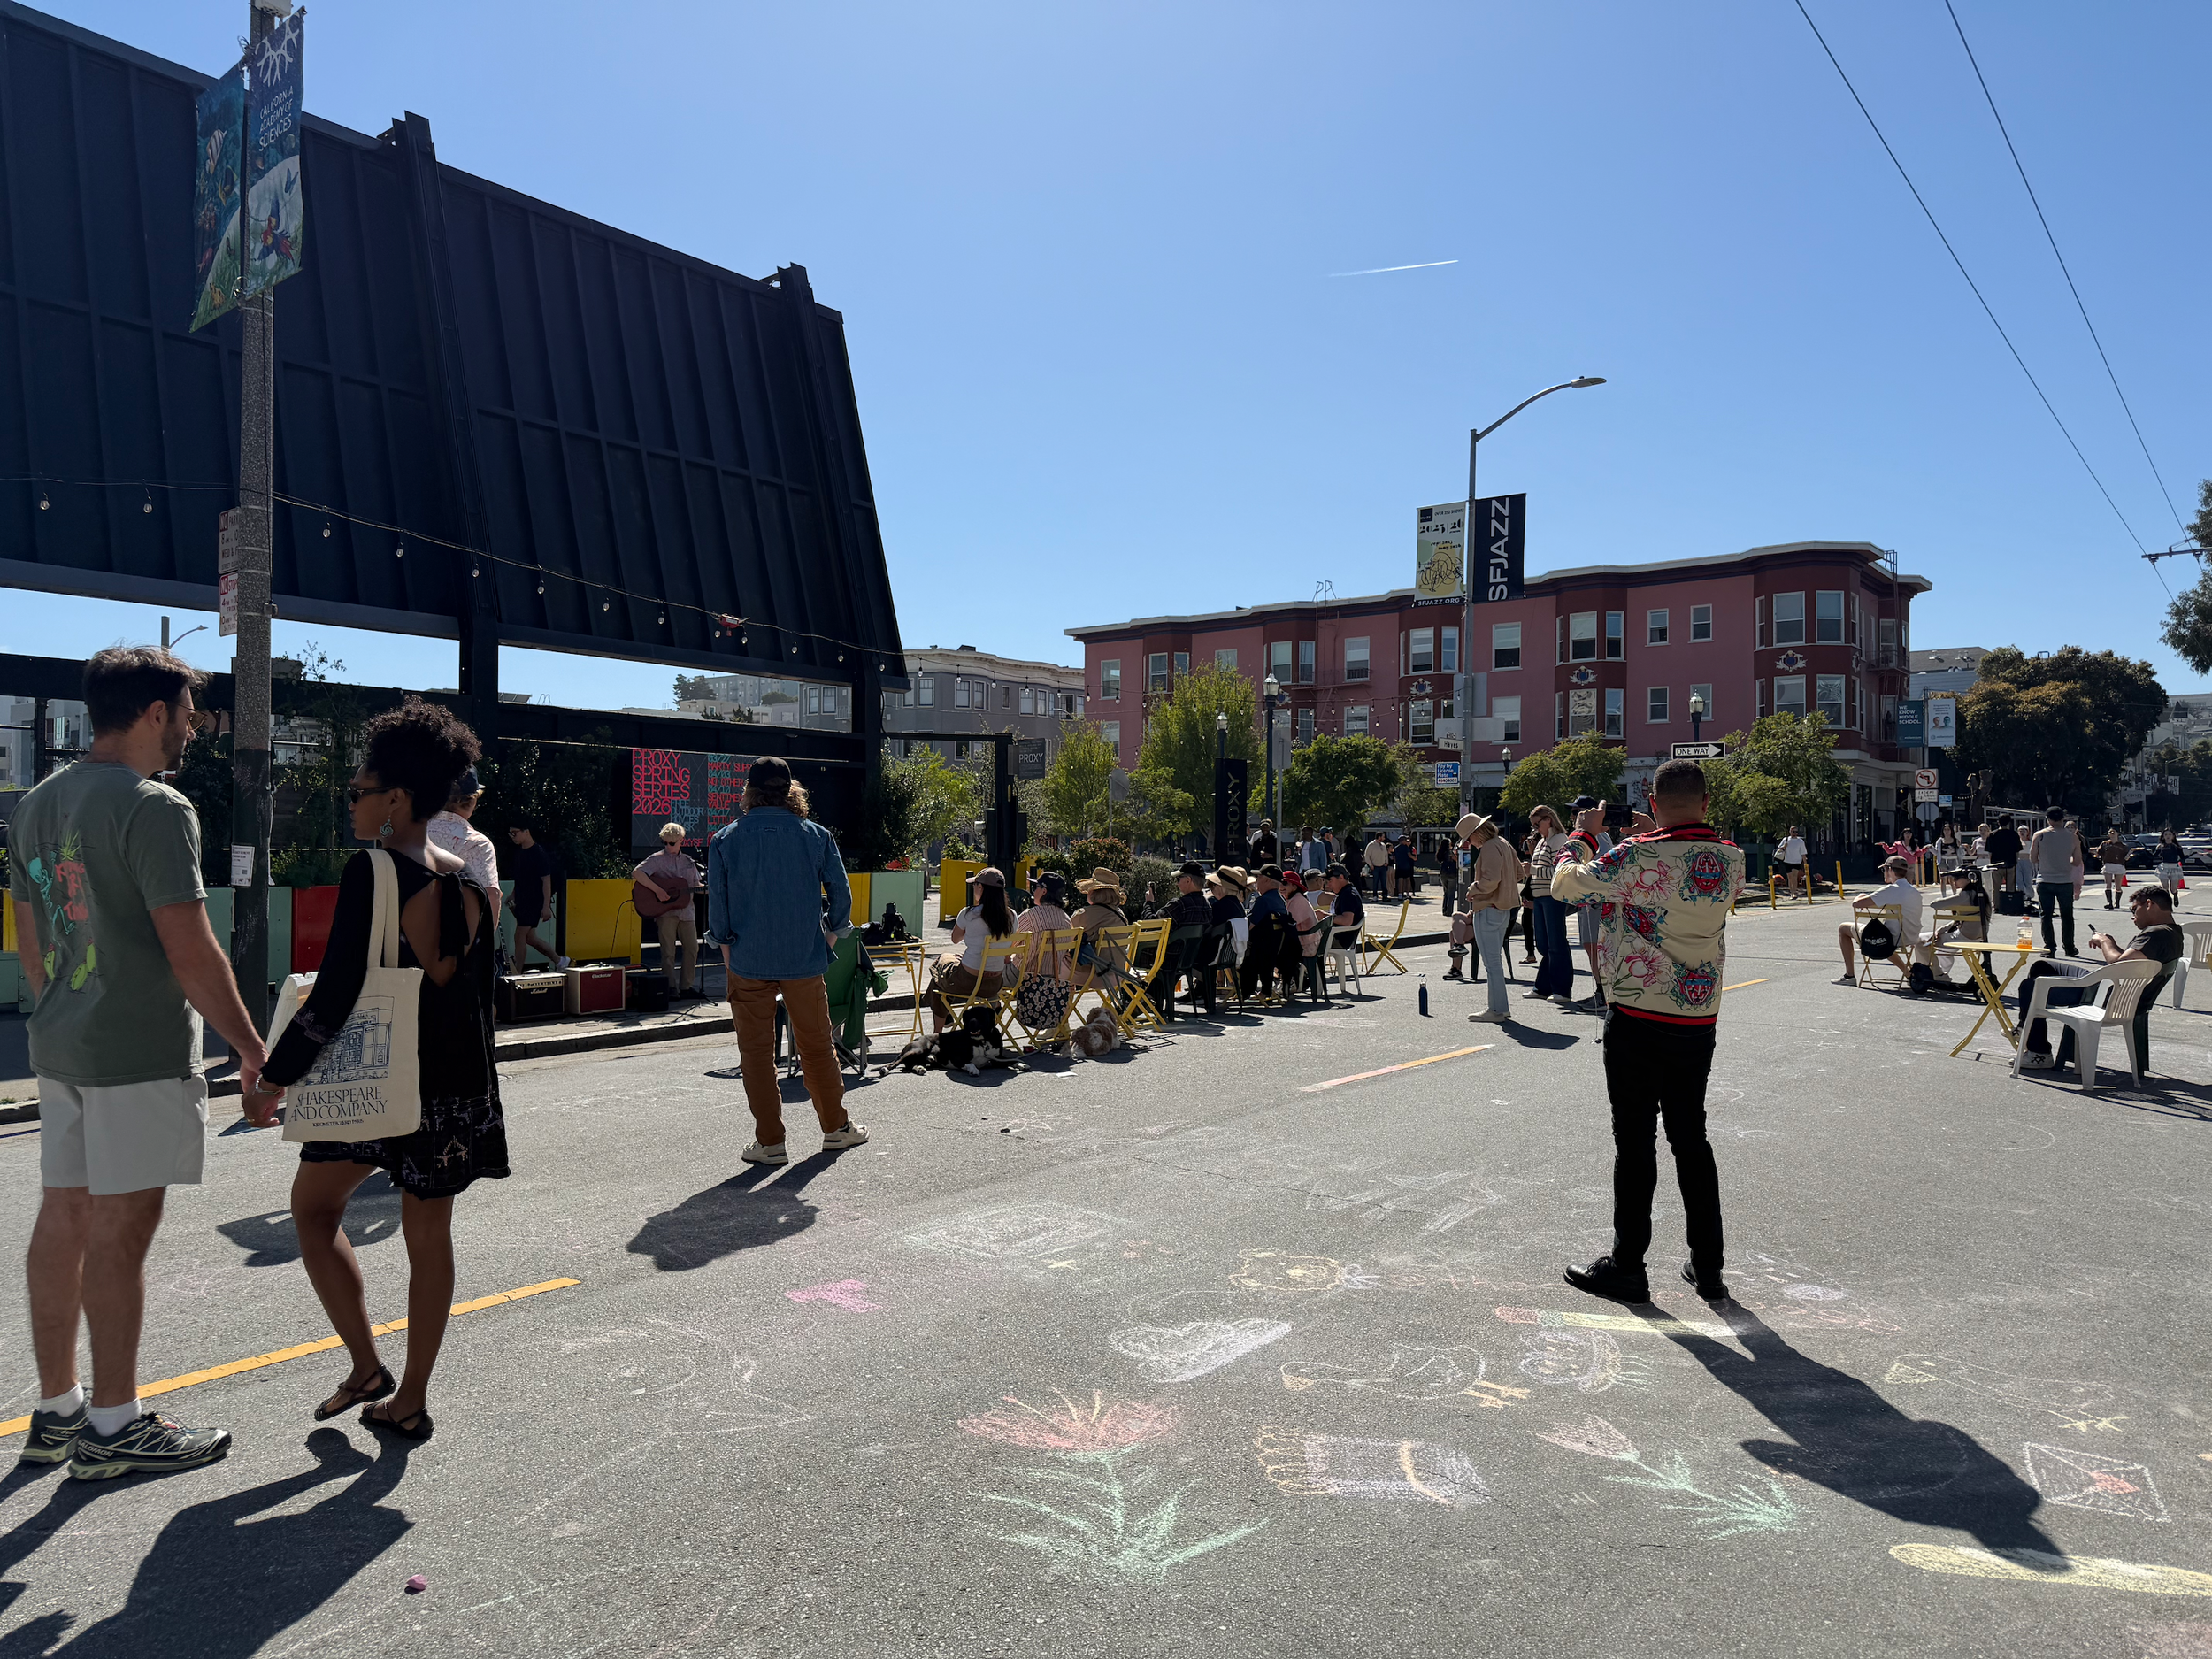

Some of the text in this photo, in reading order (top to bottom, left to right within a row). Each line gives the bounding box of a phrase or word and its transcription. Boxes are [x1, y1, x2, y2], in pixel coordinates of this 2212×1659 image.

[259, 85, 294, 119] CALIFORNIA
[259, 98, 293, 134] ACADEMY OF
[258, 113, 292, 151] SCIENCES
[220, 513, 228, 531] NO
[1488, 497, 1509, 602] SFJAZZ
[220, 576, 228, 594] NO
[1417, 597, 1460, 607] SFJAZZ.ORG
[1444, 741, 1458, 749] Hayes
[633, 749, 681, 768] PROXY
[708, 762, 732, 771] MARTY
[1018, 752, 1044, 764] PROXY
[633, 764, 691, 785] SPRING
[708, 778, 743, 787] NO OTHER
[633, 781, 691, 800] SERIES
[633, 797, 672, 815] 2026
[671, 806, 704, 816] OUTDOOR
[708, 800, 731, 810] VALUE
[1227, 772, 1240, 856] PROXY
[671, 815, 700, 824] MOVIES
[296, 1086, 382, 1107] SHAKESPEARE
[288, 1100, 388, 1122] AND COMPANY
[77, 1440, 115, 1458] SALOMON
